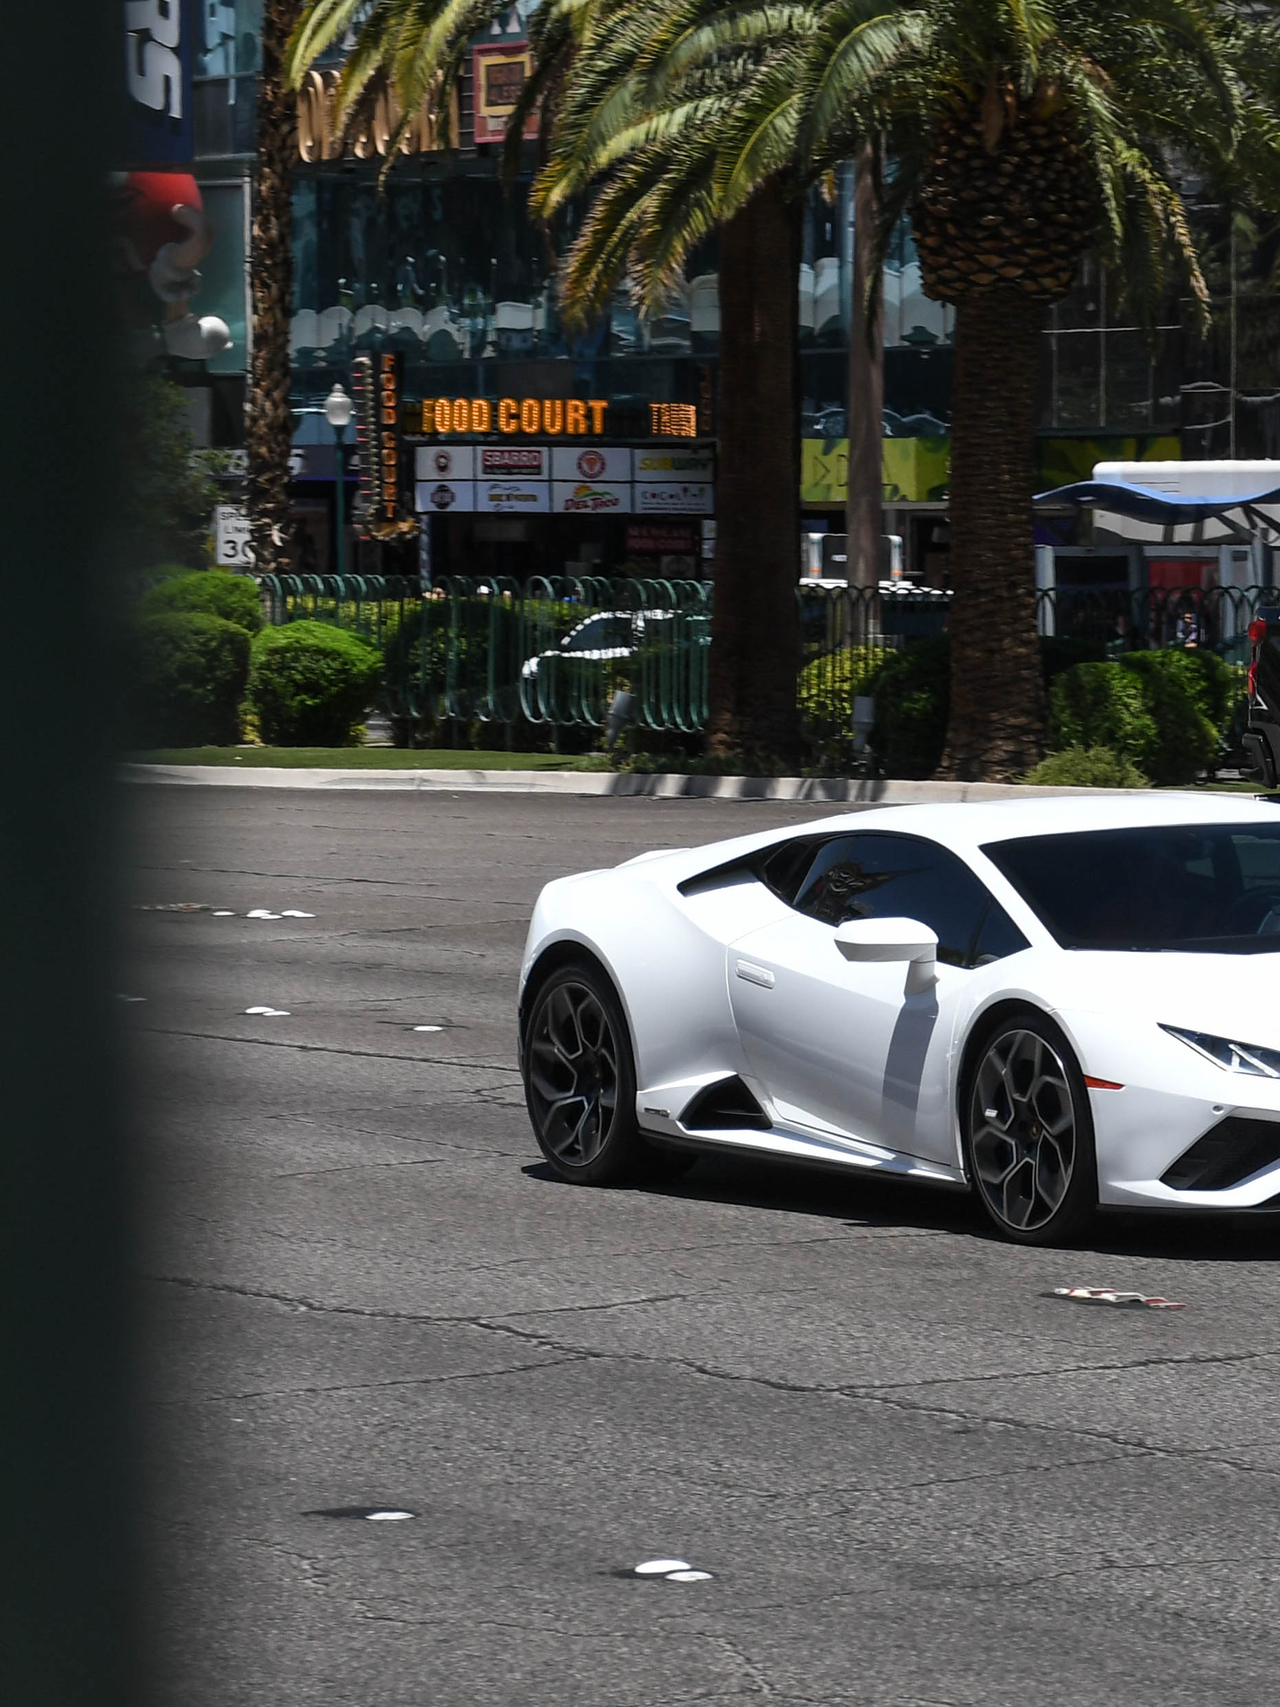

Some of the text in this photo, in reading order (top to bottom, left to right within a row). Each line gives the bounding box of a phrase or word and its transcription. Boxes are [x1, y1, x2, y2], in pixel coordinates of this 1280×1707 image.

[422, 397, 492, 433] FOOD
[497, 398, 608, 435] COURT
[381, 354, 396, 518] FOOD COURT
[484, 451, 541, 466] SBARRO
